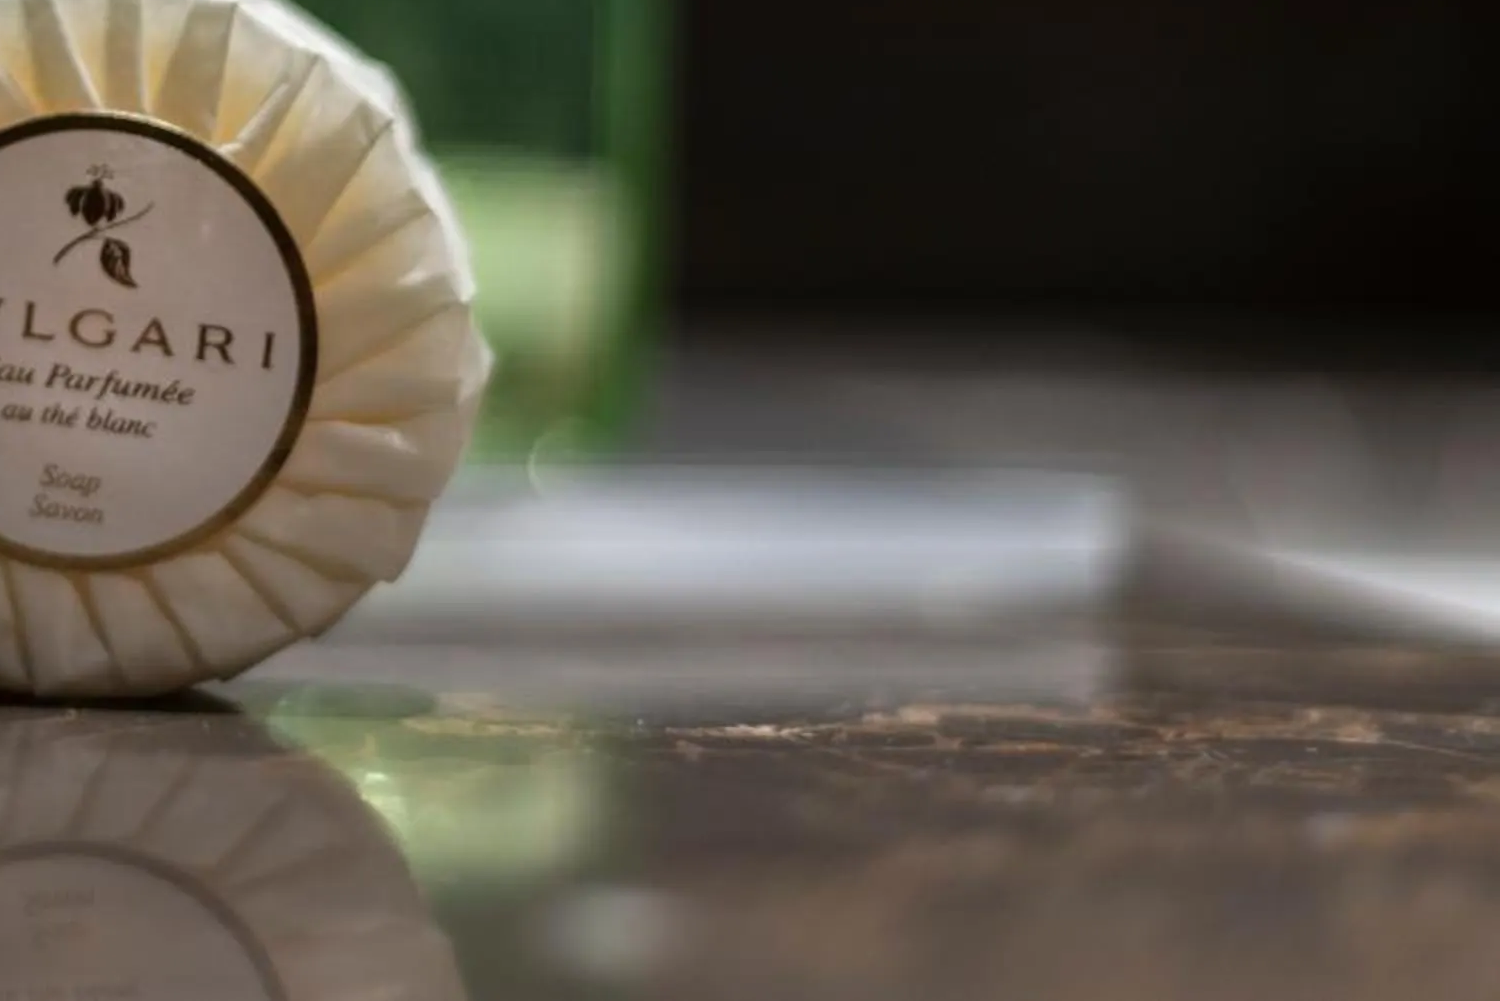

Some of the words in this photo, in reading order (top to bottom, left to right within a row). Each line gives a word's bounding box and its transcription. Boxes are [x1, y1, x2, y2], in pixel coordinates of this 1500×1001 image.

[44, 361, 197, 407] Parfumée
[0, 402, 33, 423] au
[40, 402, 79, 428] thé
[86, 403, 157, 439] blanc
[39, 463, 101, 494] Soap
[28, 494, 105, 526] Savon
